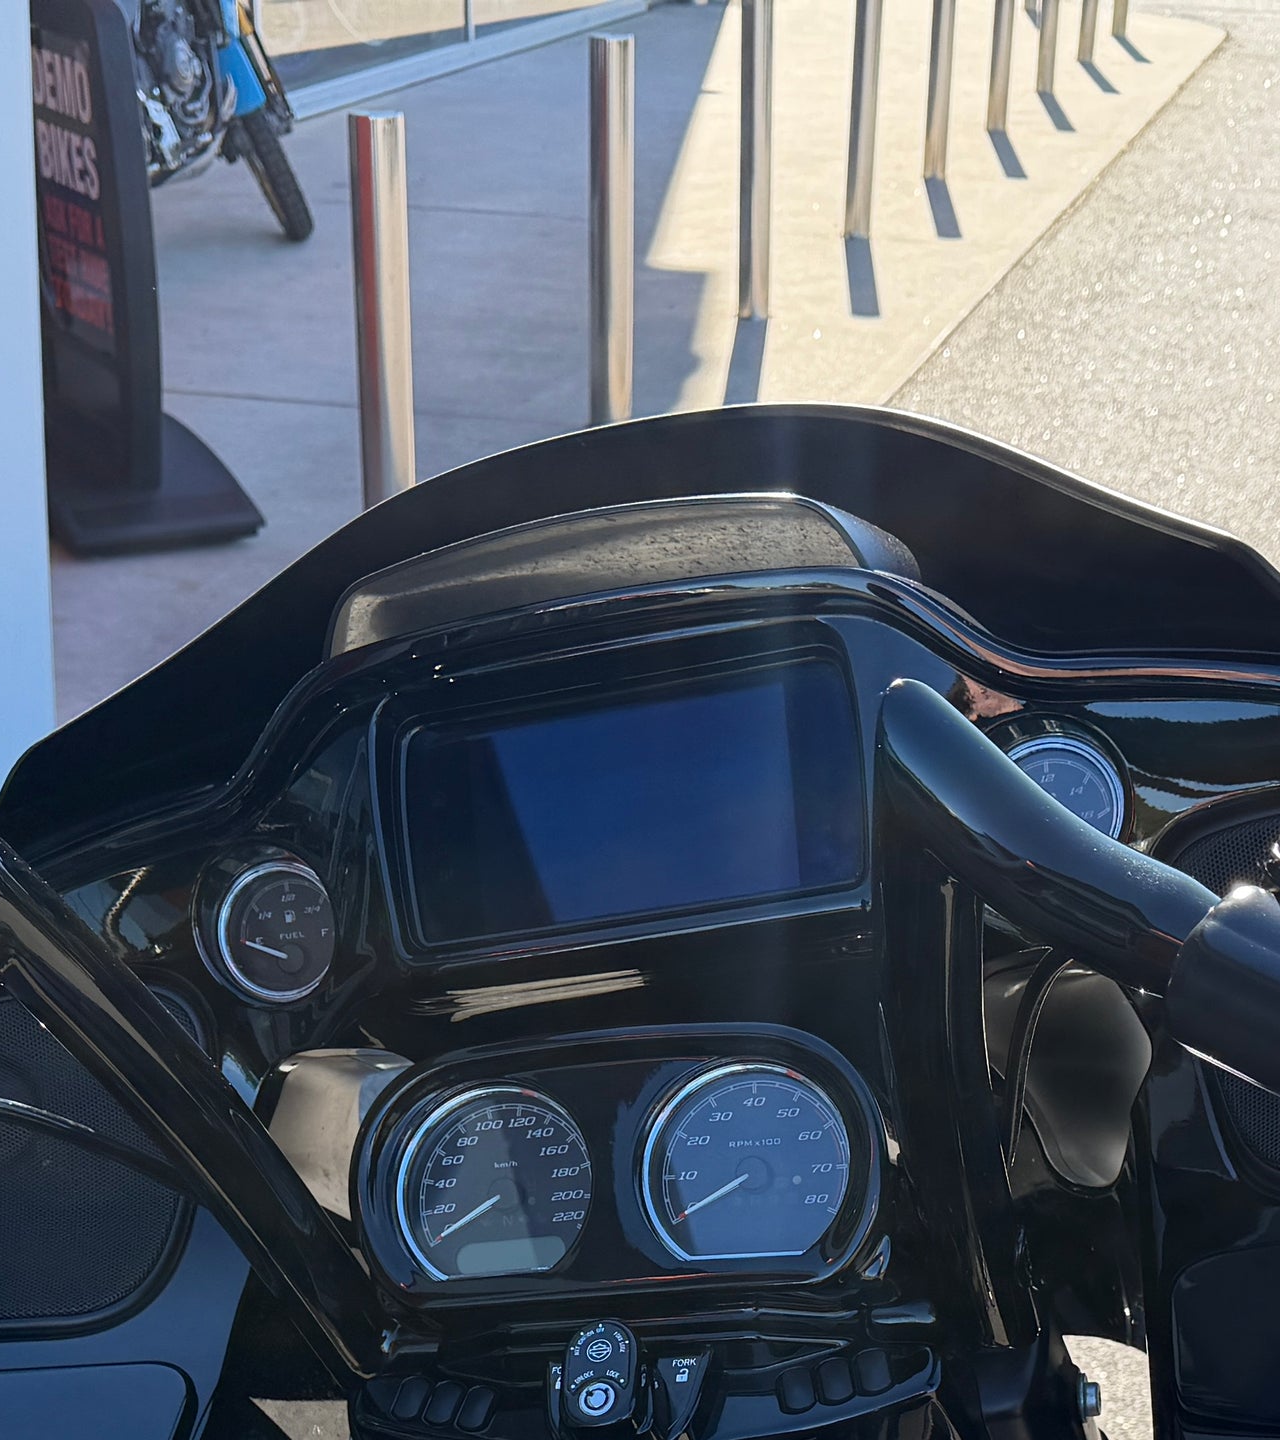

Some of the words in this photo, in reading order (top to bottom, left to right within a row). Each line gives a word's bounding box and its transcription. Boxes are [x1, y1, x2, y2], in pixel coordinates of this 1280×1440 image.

[33, 45, 92, 124] DEMO
[36, 118, 100, 200] BIKES
[280, 931, 305, 940] FUEL
[321, 928, 329, 937] F
[743, 1096, 766, 1107] 40
[708, 1111, 733, 1122] 30
[776, 1107, 800, 1118] 50
[475, 1119, 504, 1132] 100
[508, 1116, 536, 1128] 120
[525, 1127, 554, 1139] 140
[798, 1130, 822, 1141] 60
[456, 1135, 479, 1147] 80
[687, 1135, 710, 1146] 20
[539, 1144, 569, 1156] 160
[442, 1154, 465, 1166] 60
[494, 1161, 518, 1169] km/h
[551, 1166, 580, 1178] 180
[811, 1163, 833, 1174] 70
[678, 1170, 698, 1181] 10
[435, 1178, 457, 1189] 40
[551, 1189, 584, 1201] 200
[804, 1194, 829, 1204] 80
[433, 1203, 456, 1214] 20
[552, 1210, 585, 1222] 220
[672, 1358, 696, 1367] FORK
